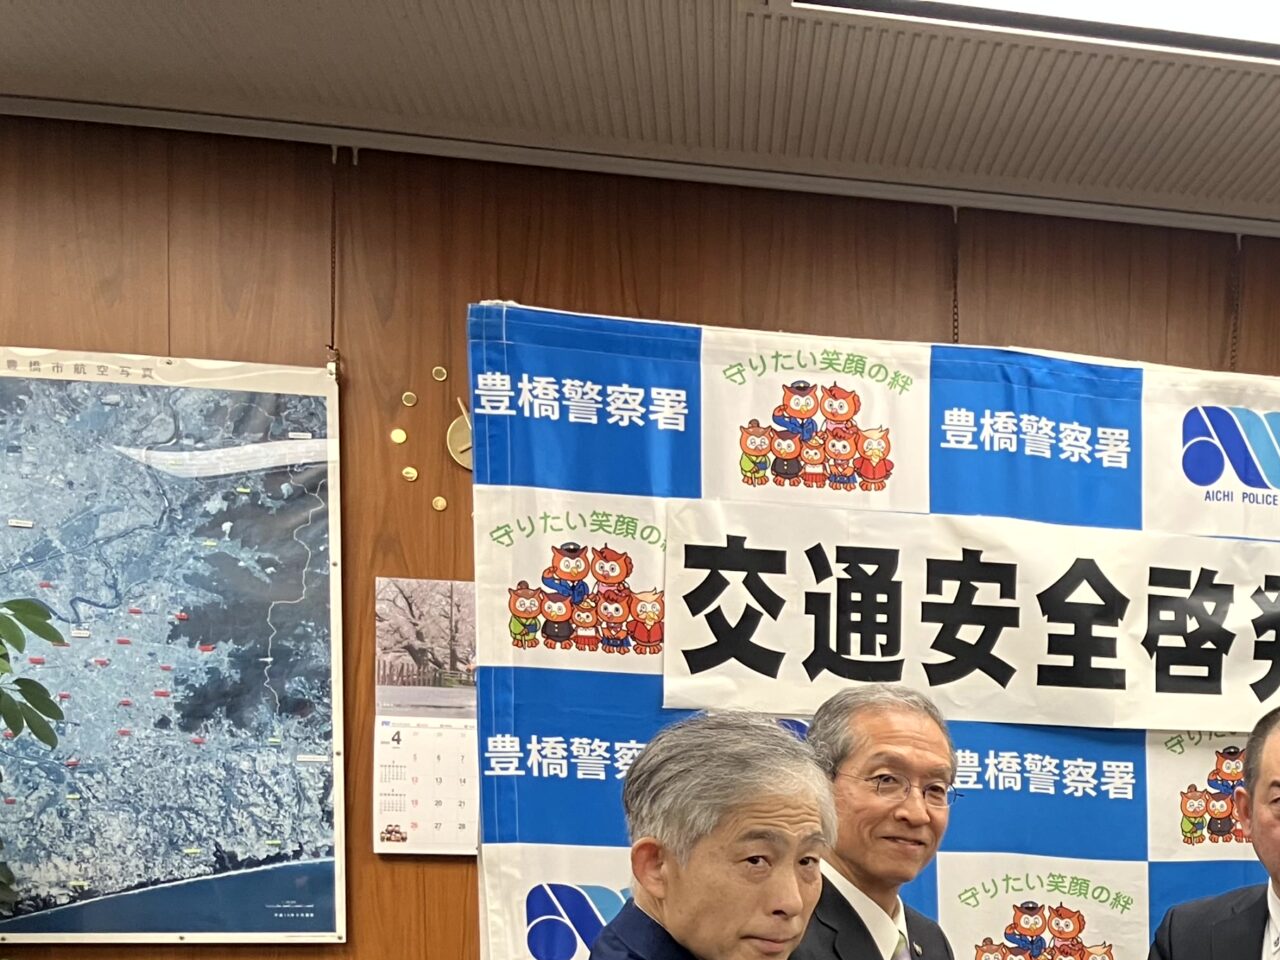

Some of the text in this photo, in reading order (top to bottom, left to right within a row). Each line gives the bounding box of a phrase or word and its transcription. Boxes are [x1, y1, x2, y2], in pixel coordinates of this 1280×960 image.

[721, 348, 914, 396] 守りたい笑顔の絆
[474, 372, 689, 433] 豊橋警察署
[940, 408, 1132, 470] 豊橋警察署
[1204, 490, 1279, 506] AICHI POLICE
[489, 510, 667, 552] 守りたい笑顔の
[391, 730, 401, 744] 4
[952, 749, 1136, 800] 豊橋警察署
[957, 871, 1134, 916] 守りたい笑顔の絆
